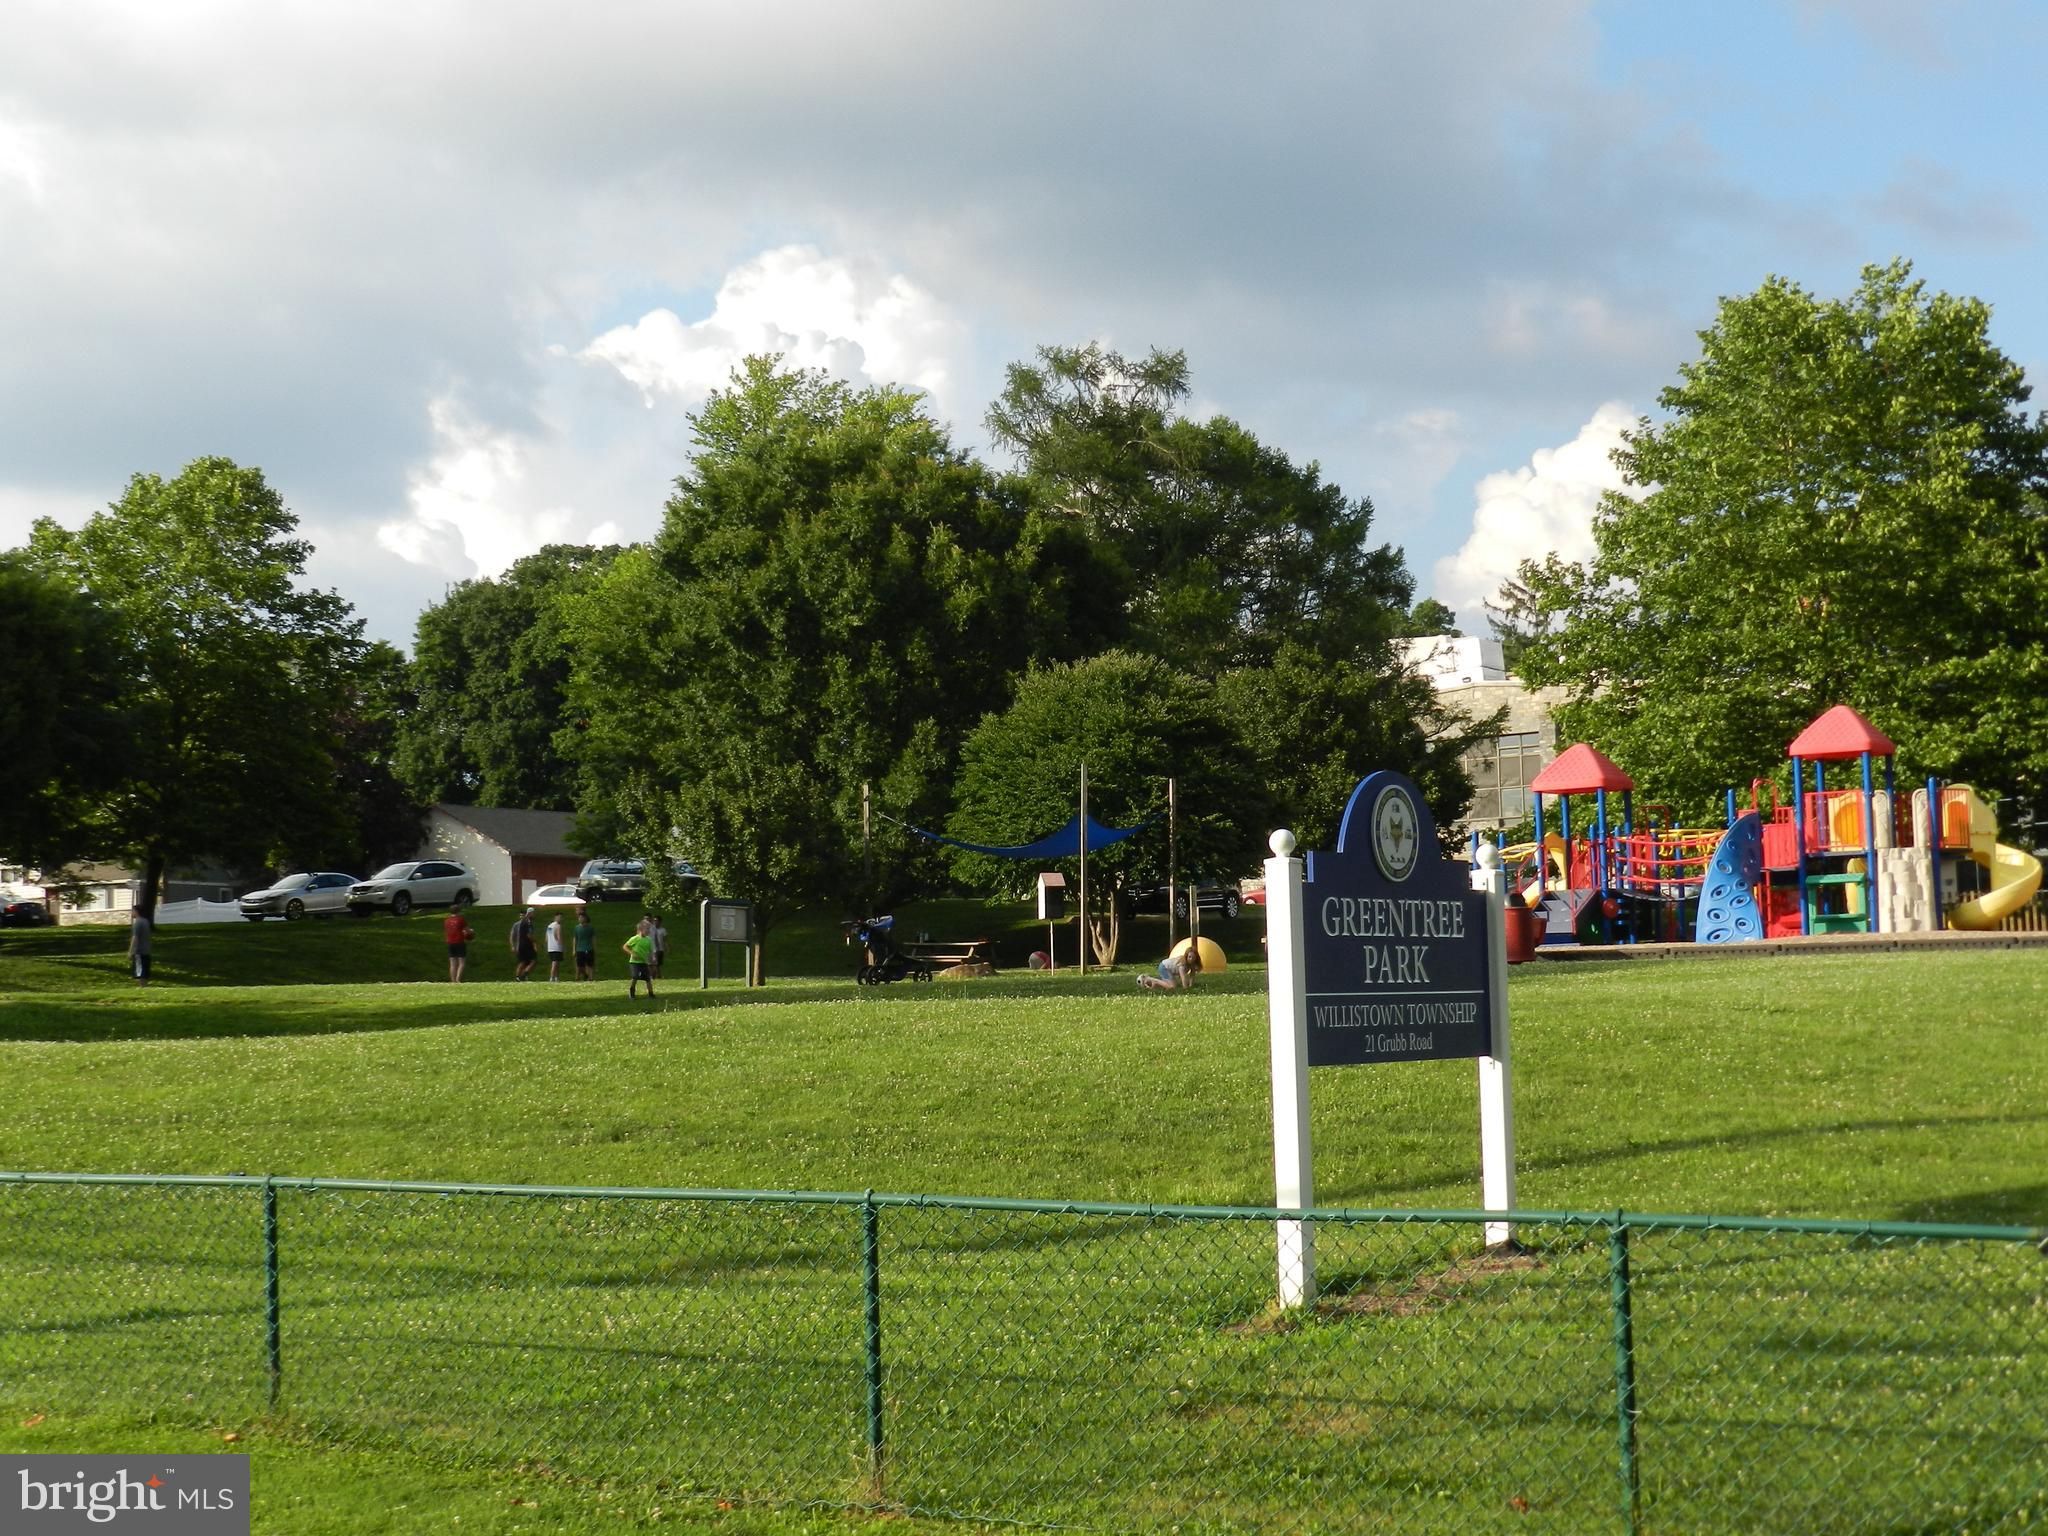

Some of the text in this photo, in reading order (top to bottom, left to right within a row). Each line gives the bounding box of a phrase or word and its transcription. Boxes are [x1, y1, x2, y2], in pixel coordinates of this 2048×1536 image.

[1321, 896, 1465, 938] GREENTREE
[1363, 944, 1431, 984] PARK
[1313, 1002, 1477, 1028] WILLISTOWN TOWNSHIP
[1364, 1031, 1433, 1053] 21 Grubb Road
